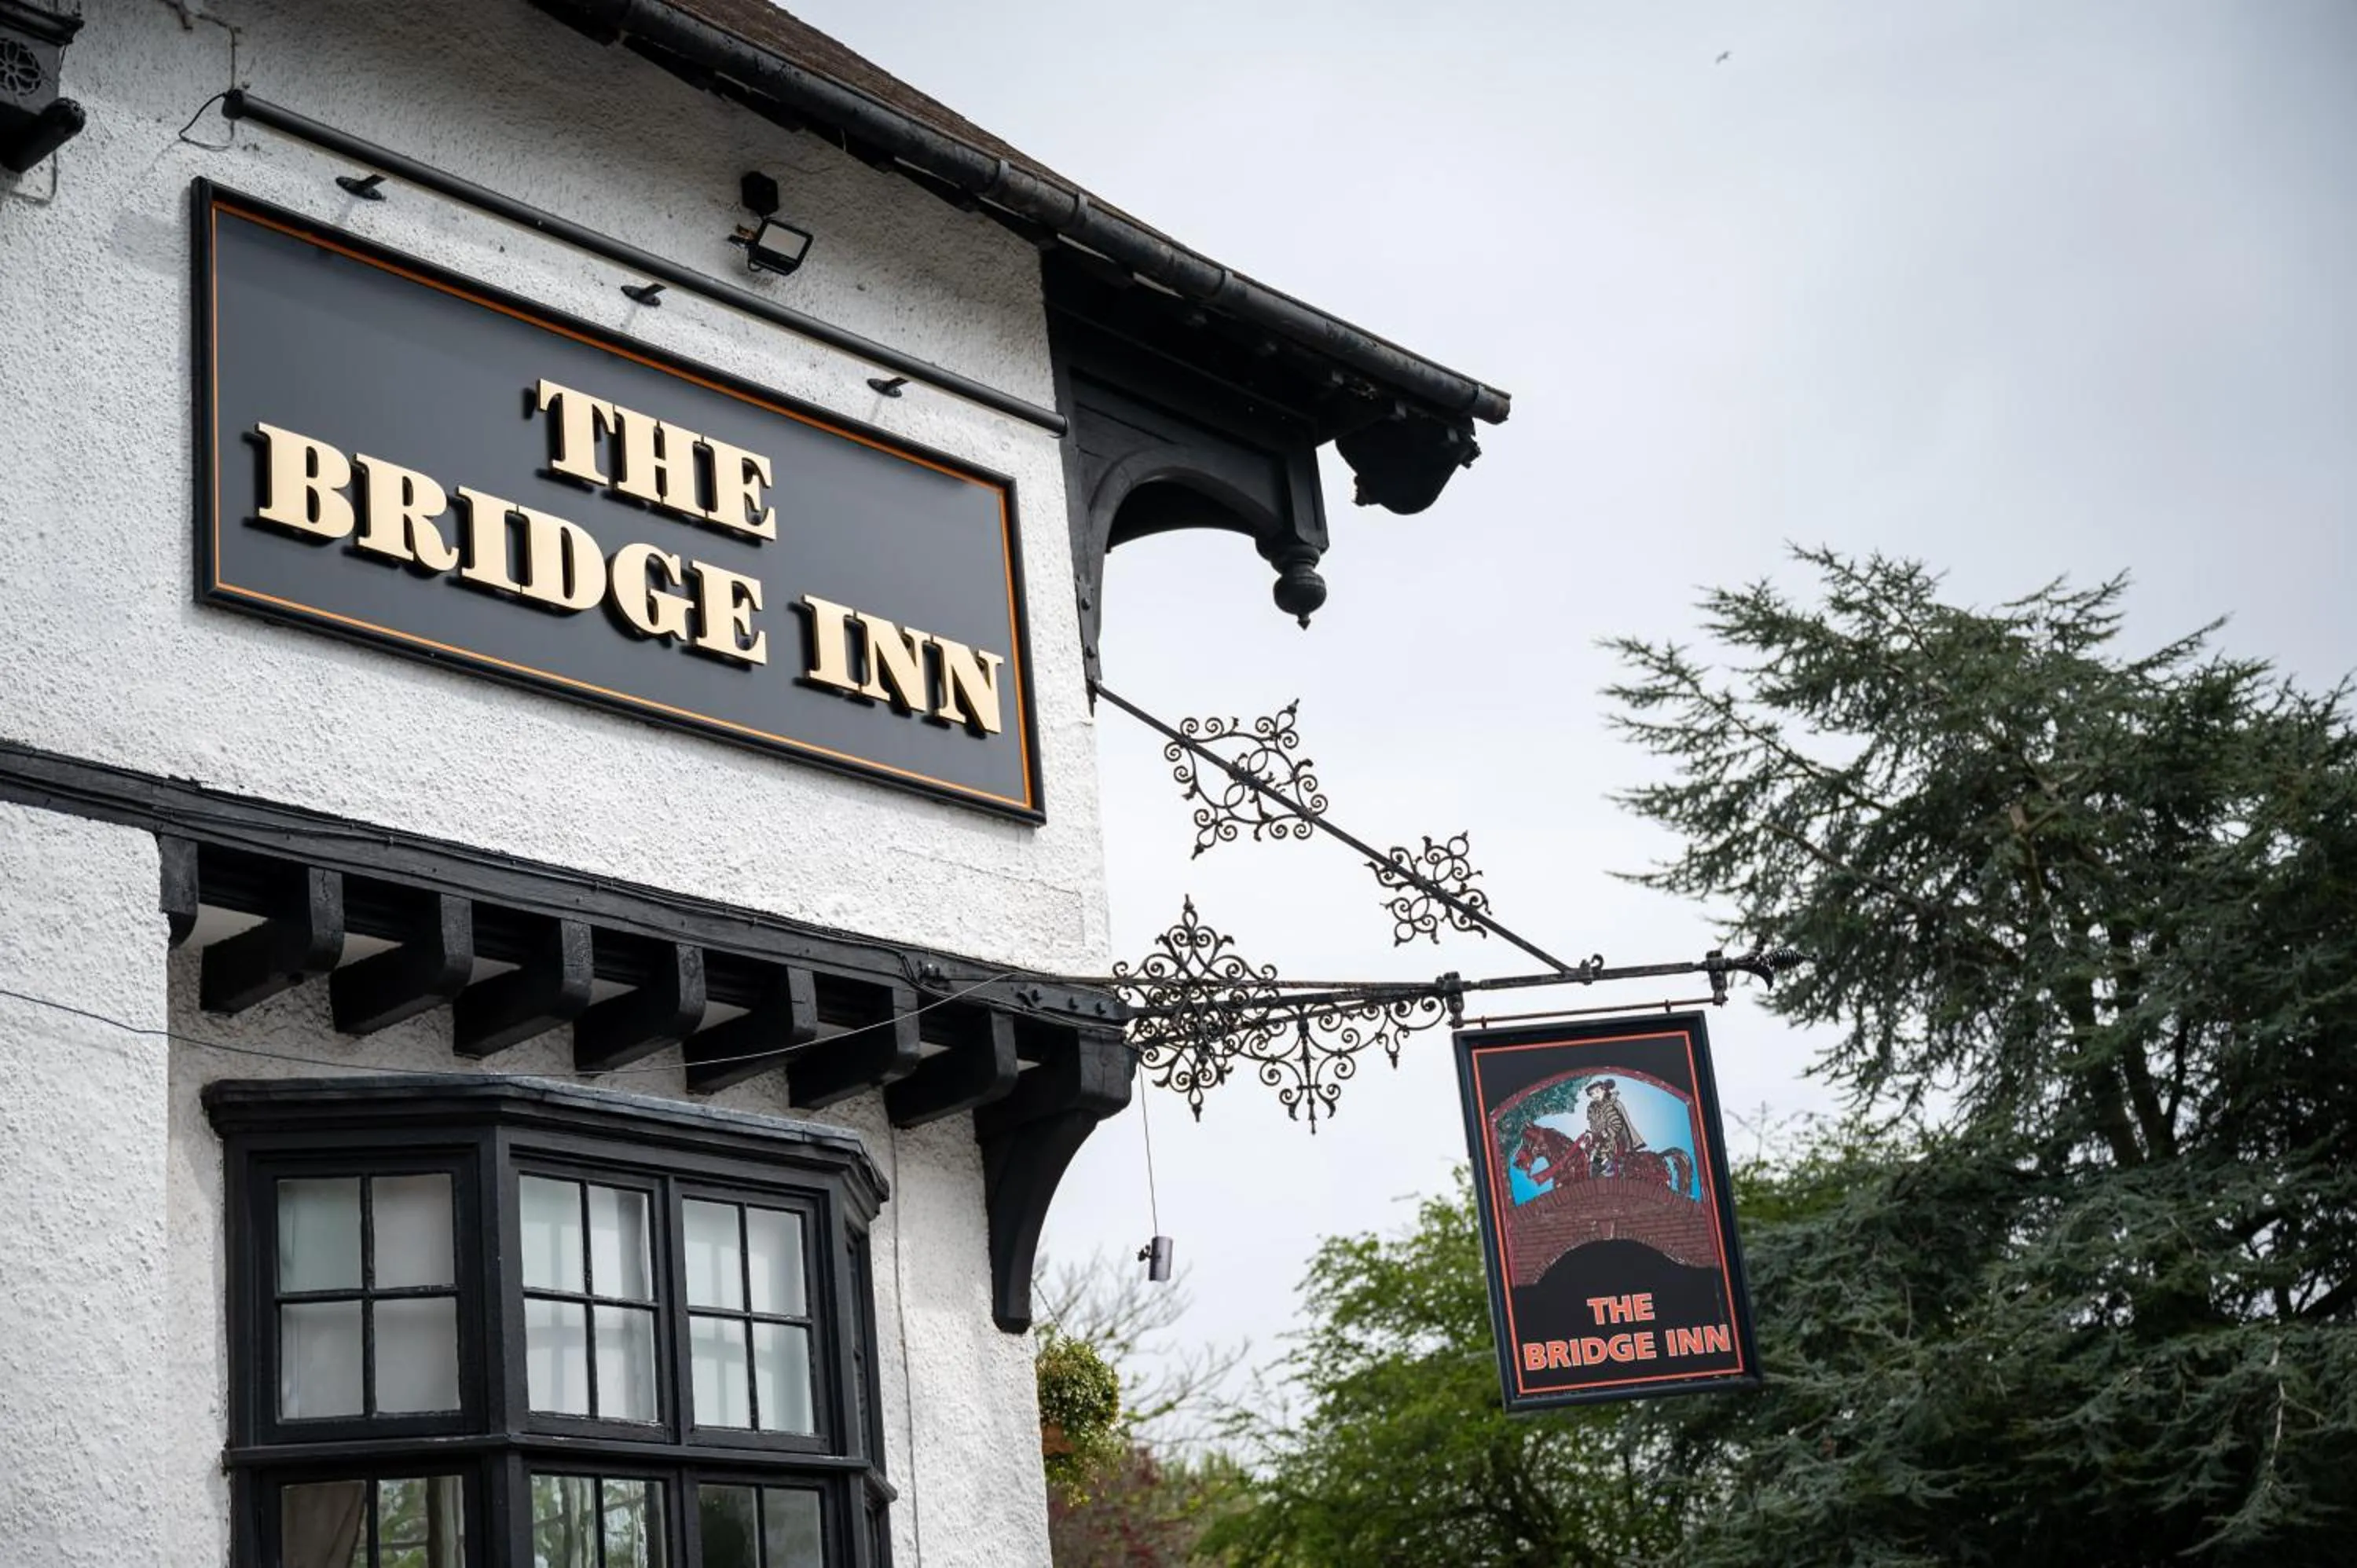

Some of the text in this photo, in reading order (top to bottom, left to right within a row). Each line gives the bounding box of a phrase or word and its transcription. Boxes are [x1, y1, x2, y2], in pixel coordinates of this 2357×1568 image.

[539, 379, 777, 541] THE
[256, 422, 1004, 735] BRIDGE INN
[1523, 1324, 1732, 1371] BRIDGE INN
[1586, 1293, 1655, 1325] THE
